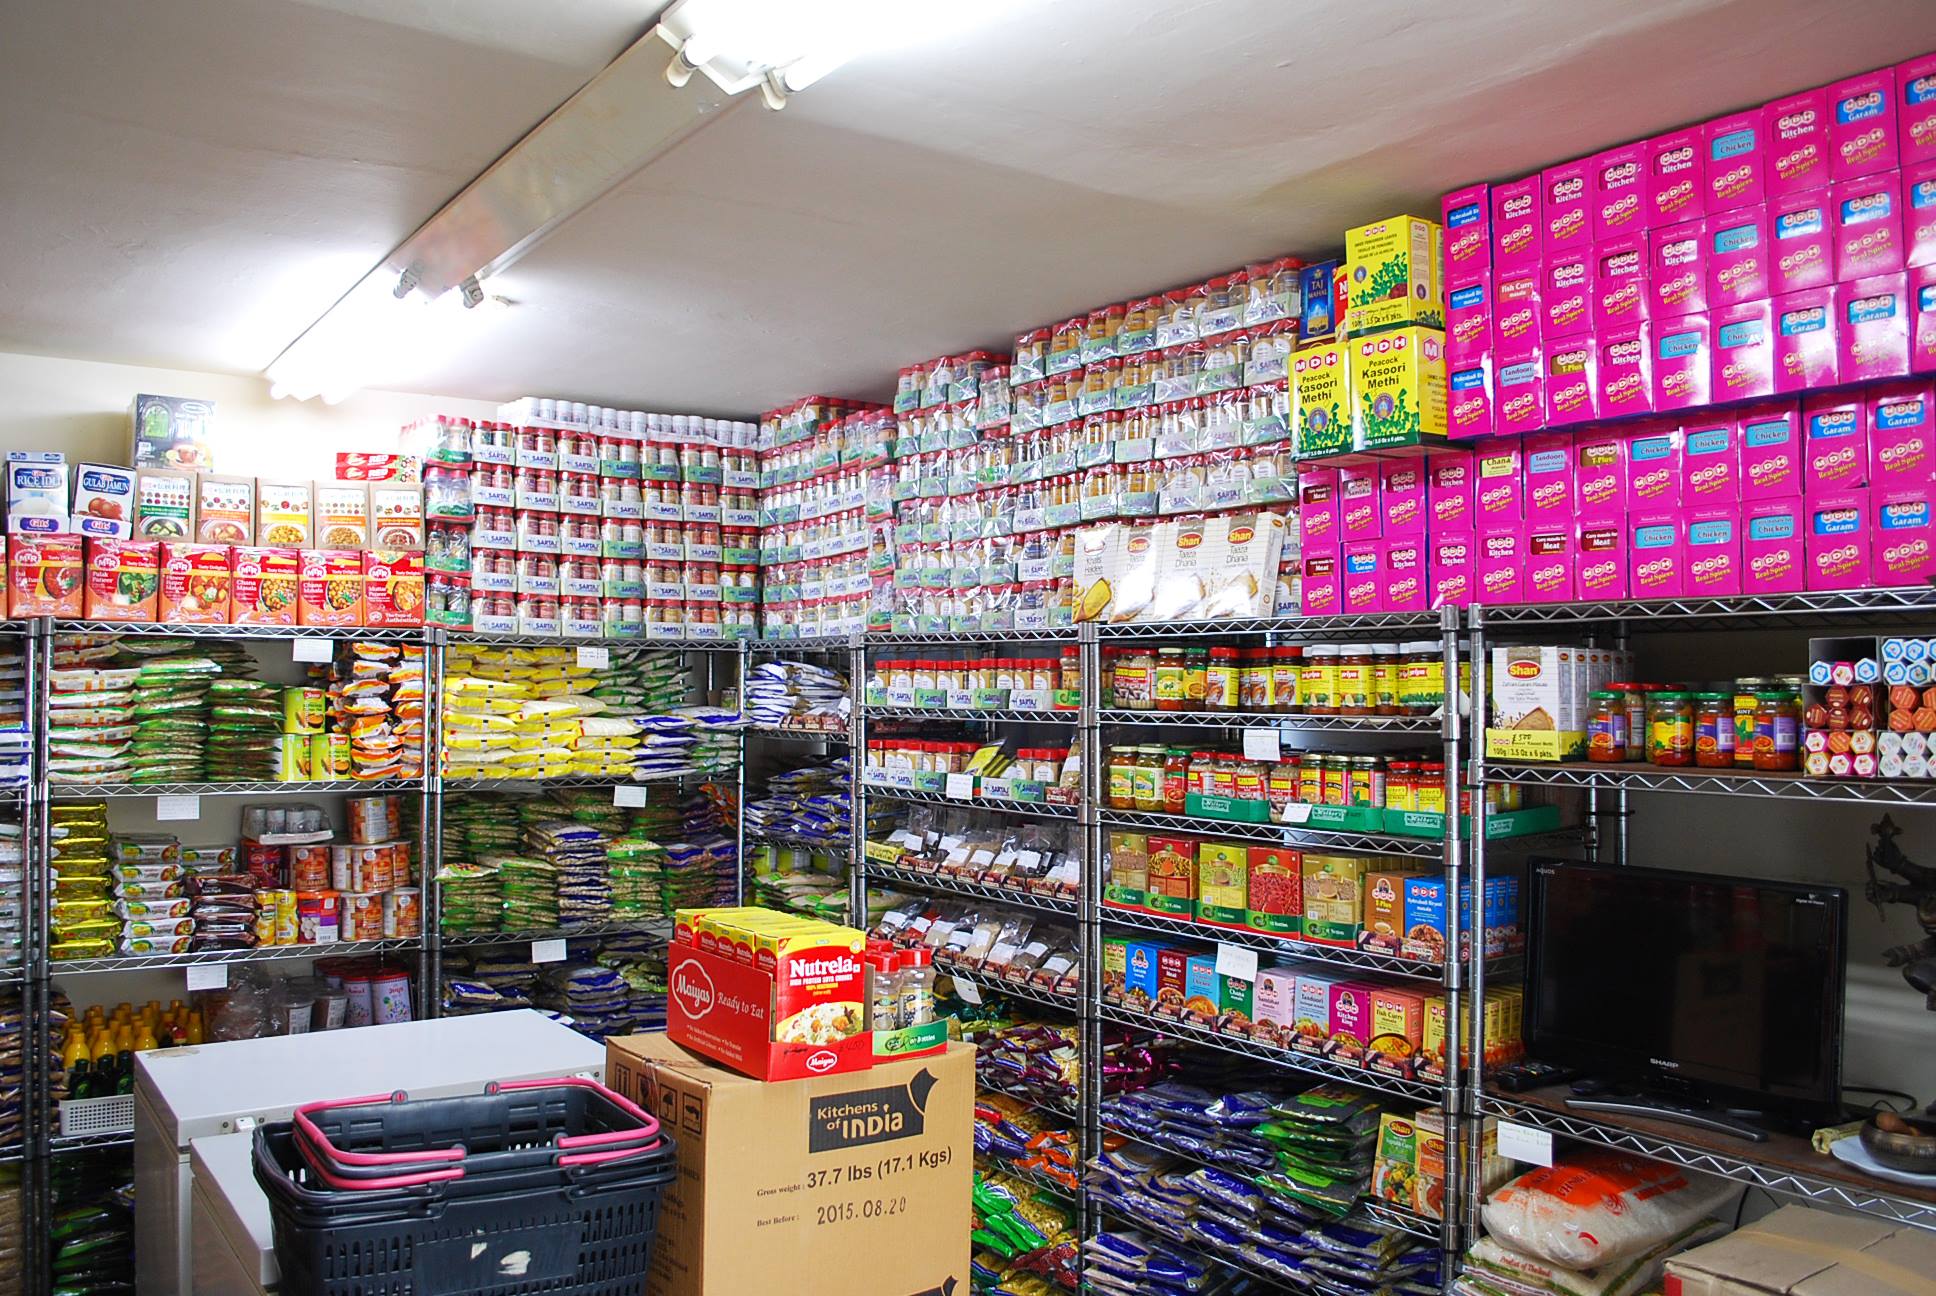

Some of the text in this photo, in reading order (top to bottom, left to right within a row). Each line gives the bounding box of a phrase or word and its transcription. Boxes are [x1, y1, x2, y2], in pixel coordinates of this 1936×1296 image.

[1312, 278, 1324, 291] TAJ
[1362, 336, 1407, 356] MDH
[1295, 353, 1337, 372] MDH
[1369, 357, 1398, 367] Peacock
[1362, 363, 1406, 379] Kasoori
[1303, 372, 1330, 383] Peacock
[1368, 376, 1399, 388] Methi
[1297, 378, 1337, 394] Kasoori
[1302, 391, 1331, 404] Methi
[1888, 416, 1917, 426] Garam
[1823, 425, 1851, 434] Garam
[1755, 431, 1787, 440] Chicken
[1695, 439, 1724, 448] Chicken
[17, 476, 39, 485] RICE
[84, 478, 105, 488] GULAB
[106, 480, 129, 491] JAMUN
[1892, 516, 1922, 525] Garam
[1826, 523, 1853, 532] Garam
[1229, 532, 1252, 543] Shan
[1698, 530, 1727, 538] Chicken
[1178, 537, 1200, 548] Shan
[99, 558, 116, 566] MTR
[171, 562, 188, 571] MTR
[241, 566, 257, 574] MTR
[307, 569, 322, 577] MTR
[1510, 666, 1538, 675] Shan
[790, 956, 853, 978] Nutrela
[677, 974, 710, 1007] Maiyas
[717, 992, 763, 1019] Ready to Eat
[1388, 1012, 1403, 1021] Curry
[1342, 1019, 1353, 1027] King
[810, 1057, 834, 1067] Maiyas
[1650, 1057, 1678, 1069] SHARP
[818, 1102, 878, 1120] Kitchens
[827, 1119, 840, 1130] of
[1391, 1122, 1411, 1135] Shan
[1428, 1140, 1444, 1152] Sha
[807, 1146, 951, 1189] 37.7 lbs (17.1 Kgs)
[757, 1184, 800, 1197] Gross weight
[757, 1215, 795, 1227] Best Before
